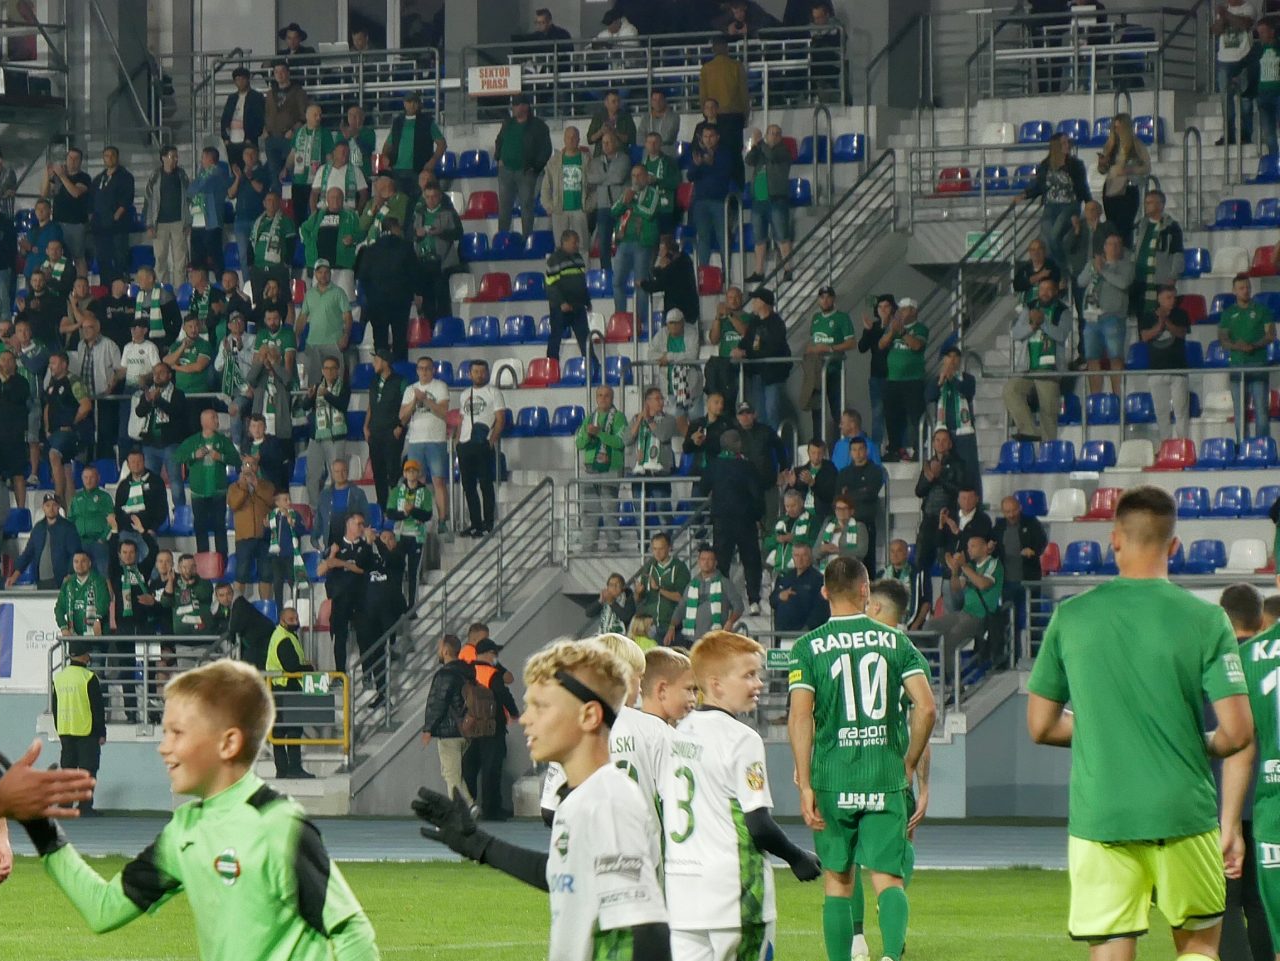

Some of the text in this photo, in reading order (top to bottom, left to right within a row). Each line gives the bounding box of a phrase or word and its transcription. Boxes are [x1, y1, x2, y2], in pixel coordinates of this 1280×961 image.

[479, 67, 510, 78] SEKTOR
[481, 79, 508, 89] PRASA
[811, 631, 897, 655] RADECKI
[305, 673, 330, 693] A-4
[831, 652, 888, 722] 10
[671, 766, 695, 843] 3
